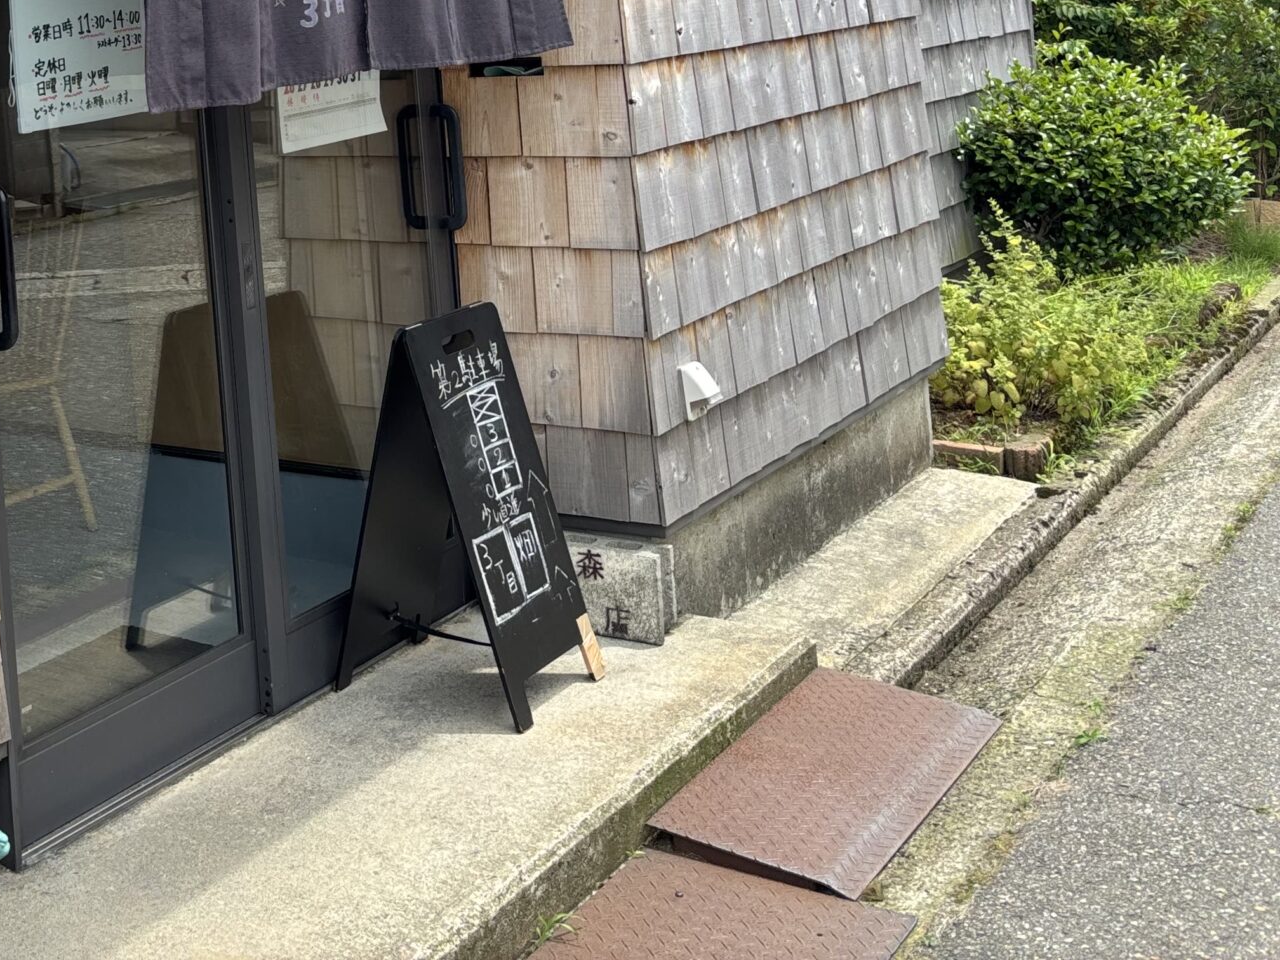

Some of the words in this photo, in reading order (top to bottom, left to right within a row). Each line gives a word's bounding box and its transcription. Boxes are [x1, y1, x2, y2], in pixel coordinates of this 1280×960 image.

[34, 57, 65, 77] 定休日
[486, 423, 498, 442] 3
[493, 447, 507, 465] 2
[480, 543, 518, 594] 3丁目
[576, 549, 605, 580] 森
